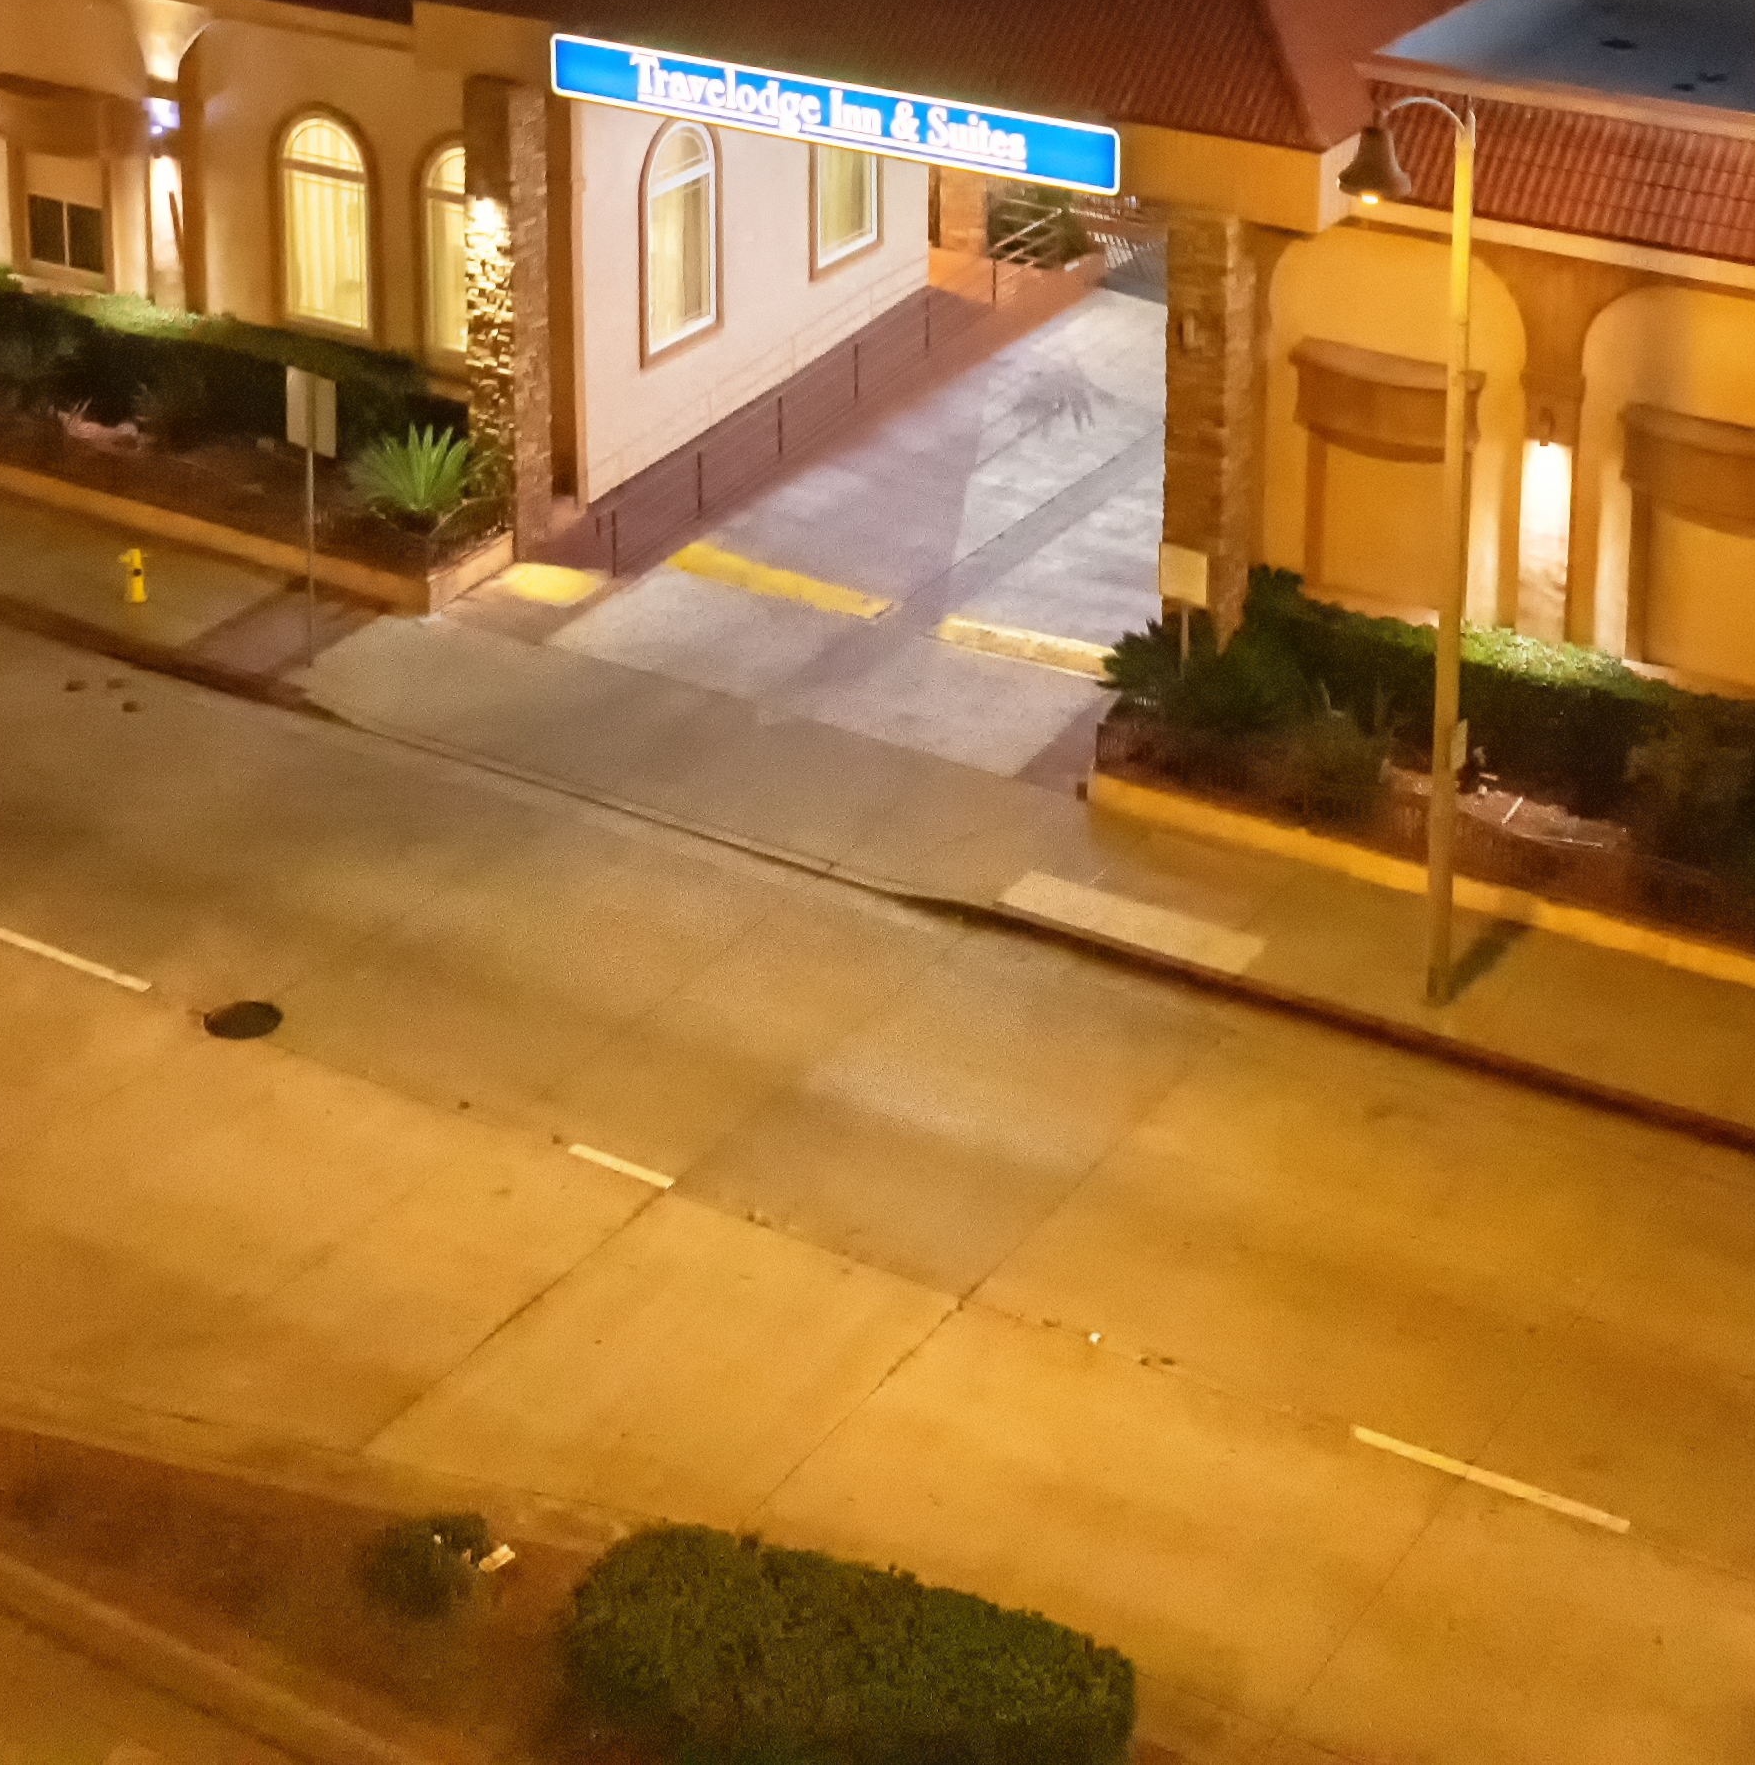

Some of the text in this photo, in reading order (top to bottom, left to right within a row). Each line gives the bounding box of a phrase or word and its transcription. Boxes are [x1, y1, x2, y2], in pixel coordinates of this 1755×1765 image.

[630, 52, 1027, 161] Travelodge Inn & Suites
